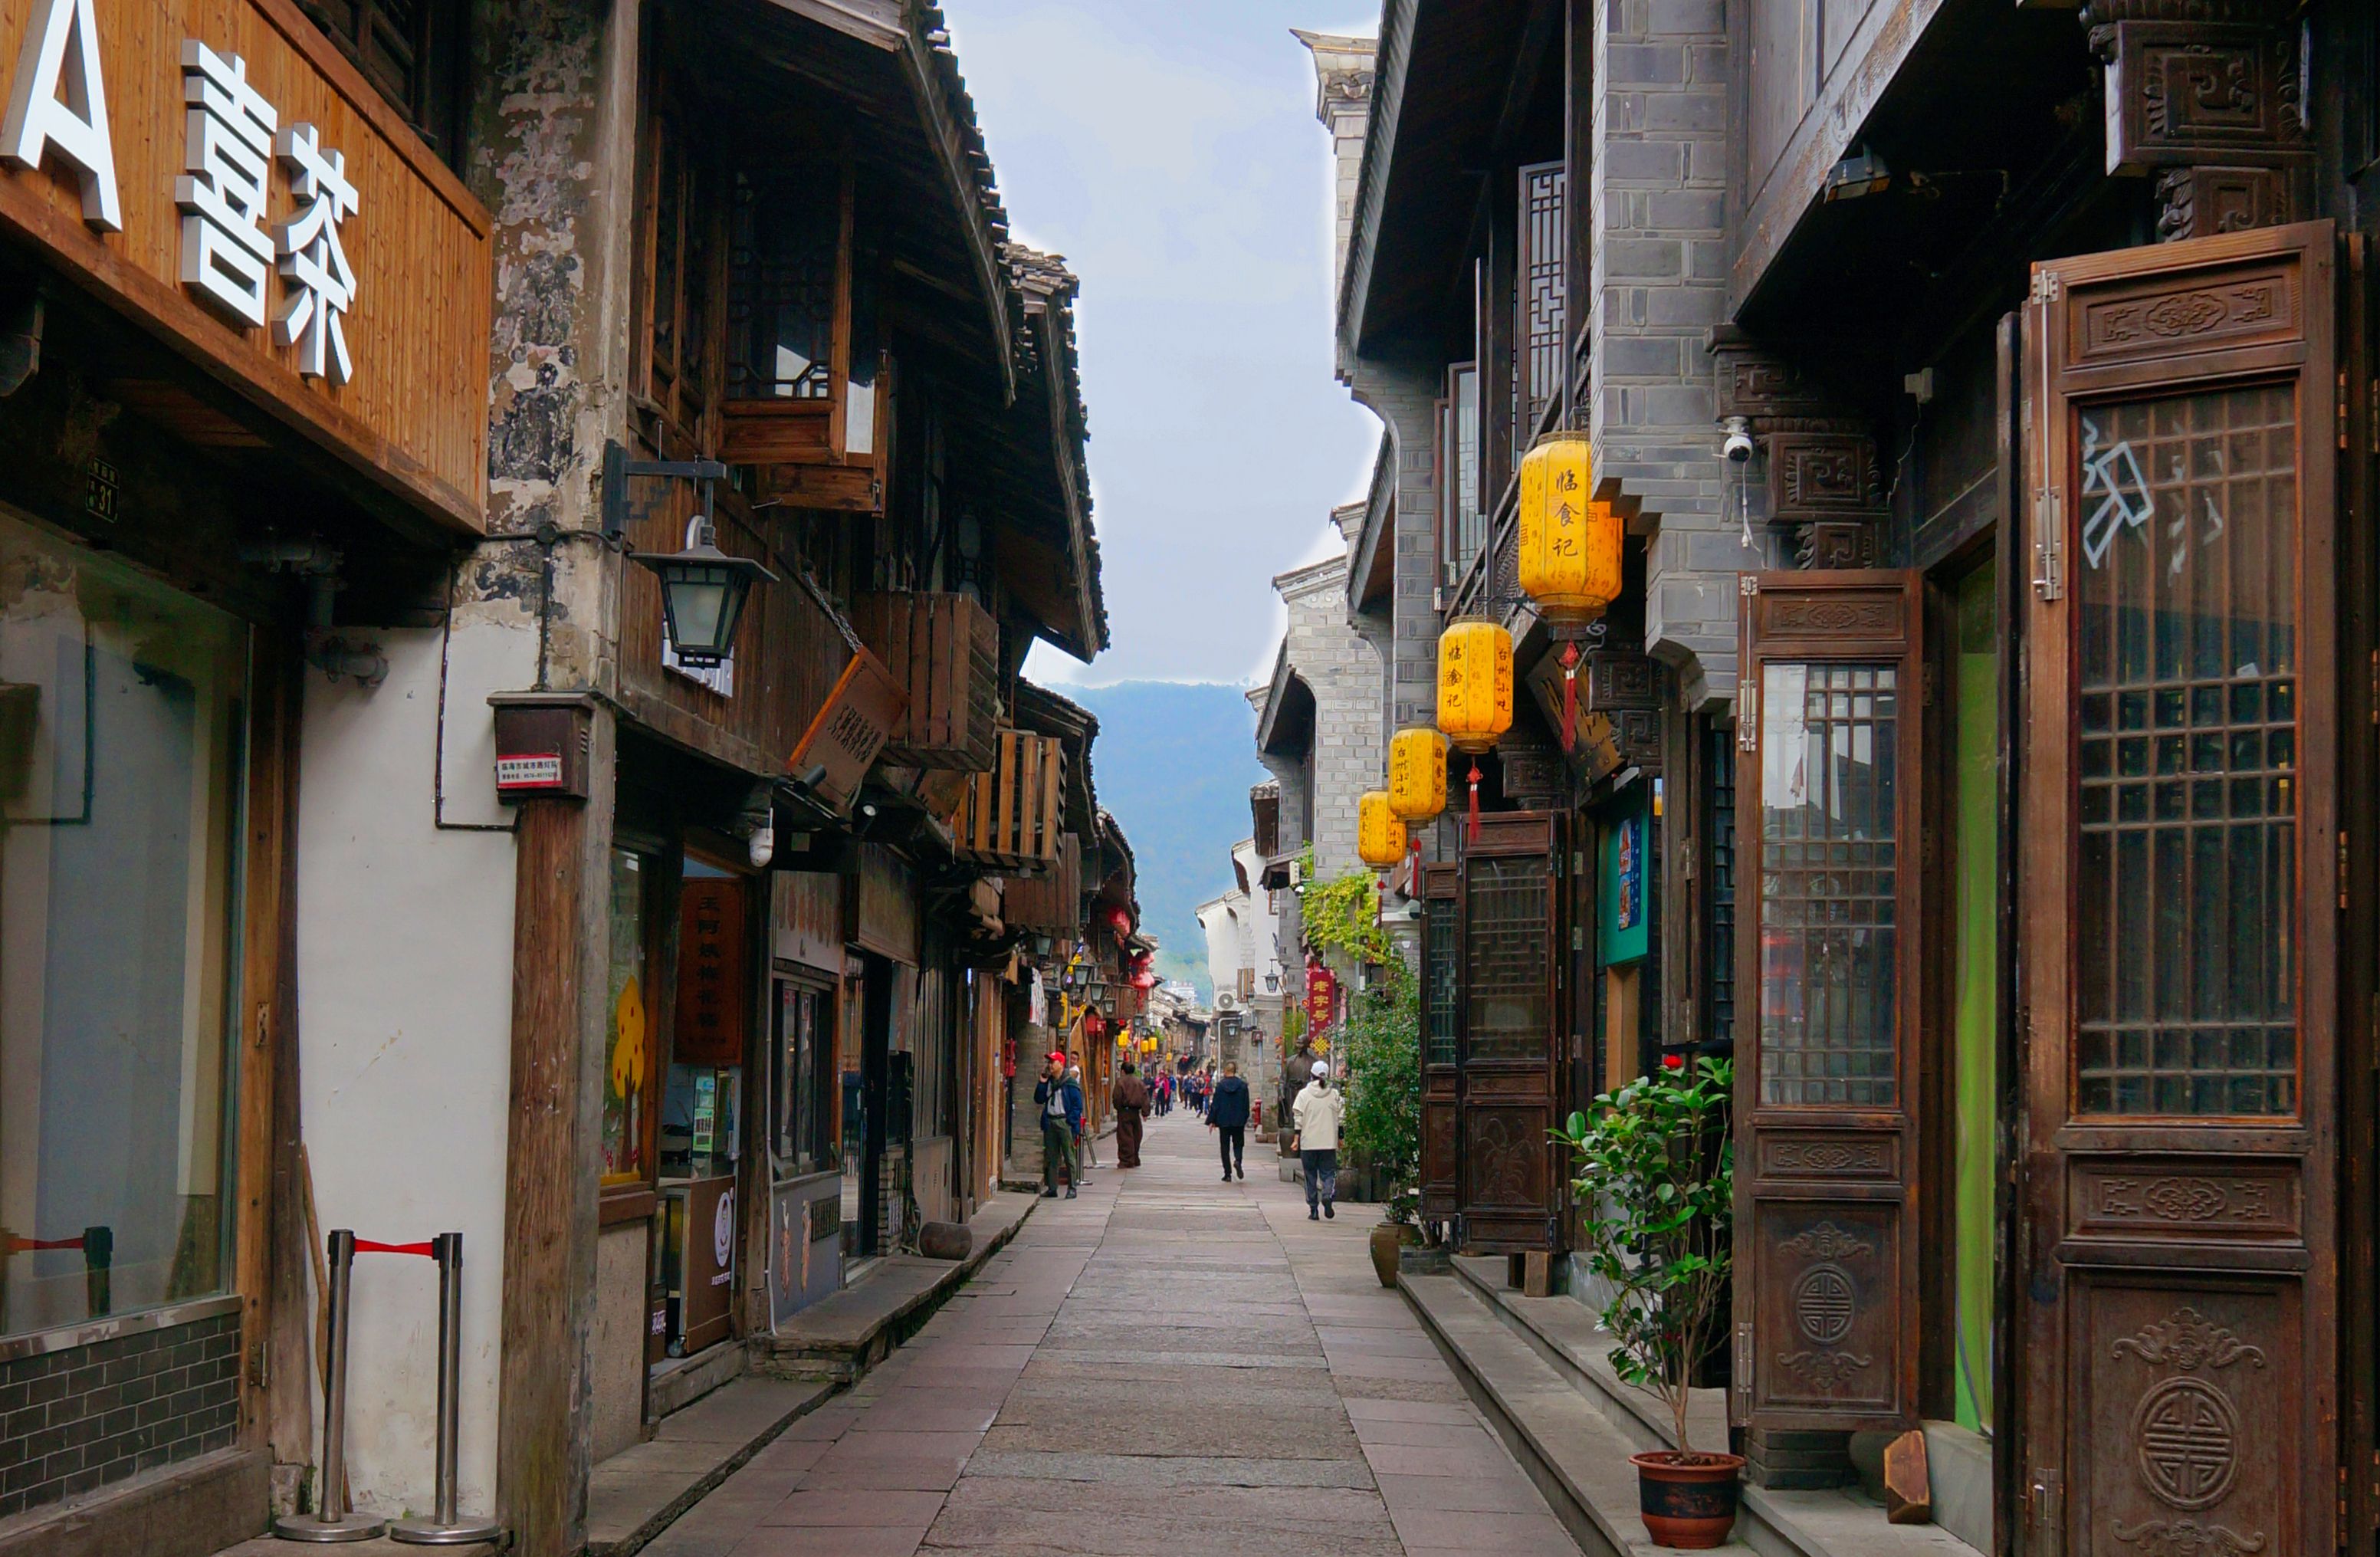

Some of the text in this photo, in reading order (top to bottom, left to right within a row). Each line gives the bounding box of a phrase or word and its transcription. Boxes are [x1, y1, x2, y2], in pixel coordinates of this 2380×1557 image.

[176, 38, 359, 383] 喜茶
[99, 485, 113, 515] 31
[1553, 468, 1581, 558] 临食记
[1496, 649, 1511, 712] 台州小吃
[1388, 818, 1401, 849] 州小吃
[1312, 980, 1329, 1021] 老字号
